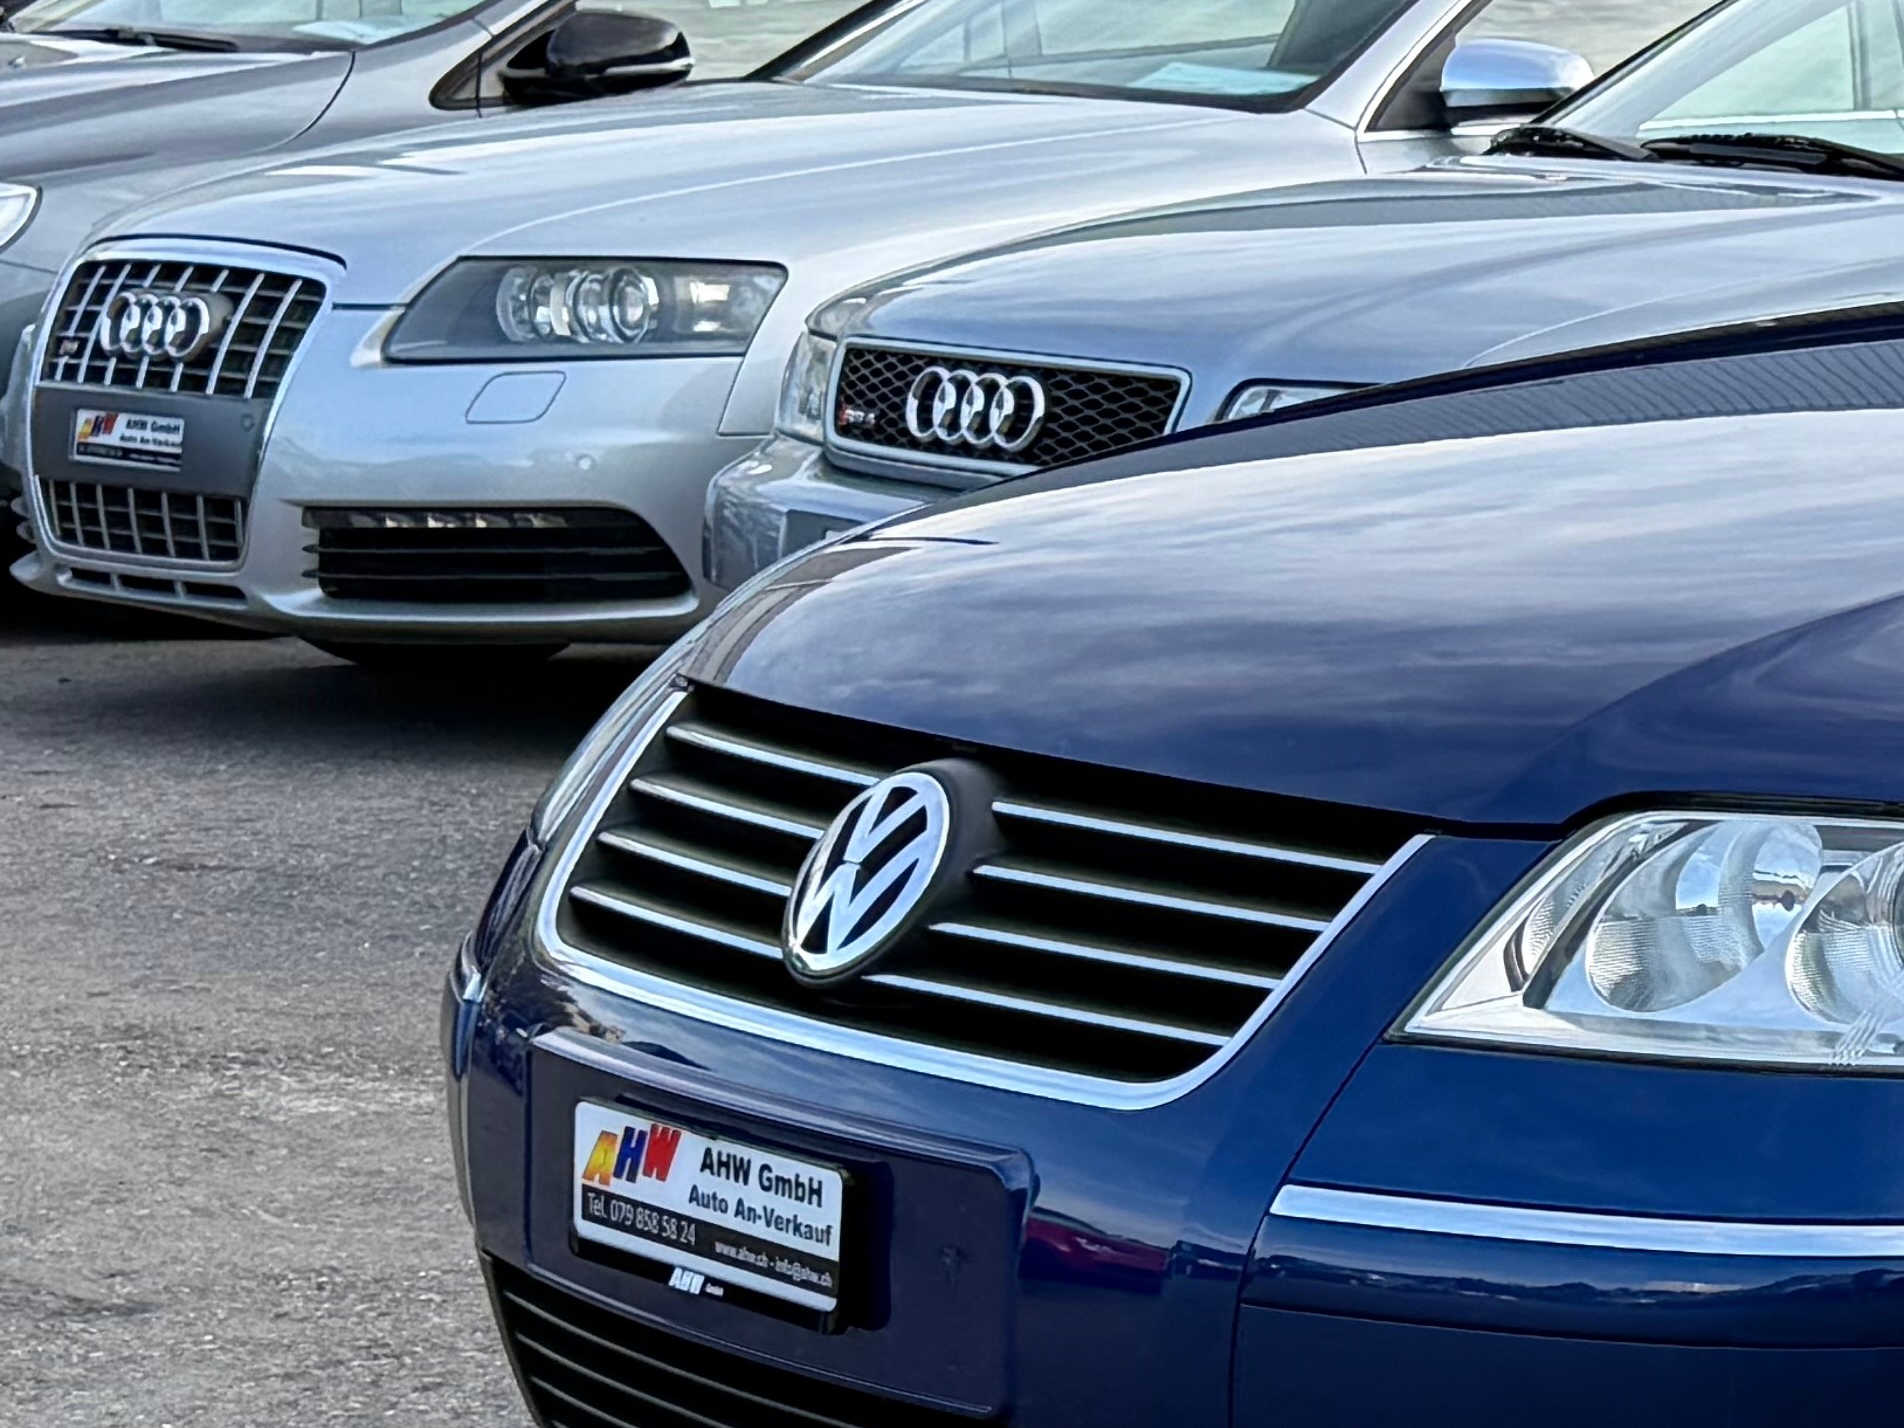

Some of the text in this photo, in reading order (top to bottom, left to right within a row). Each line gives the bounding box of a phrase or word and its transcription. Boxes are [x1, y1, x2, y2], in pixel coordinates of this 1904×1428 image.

[582, 1123, 682, 1186] AHW
[700, 1147, 823, 1208] AHW GmbH
[587, 1192, 697, 1246] Tel. 079 858 58 24
[688, 1184, 833, 1246] Auto An-Verkauf
